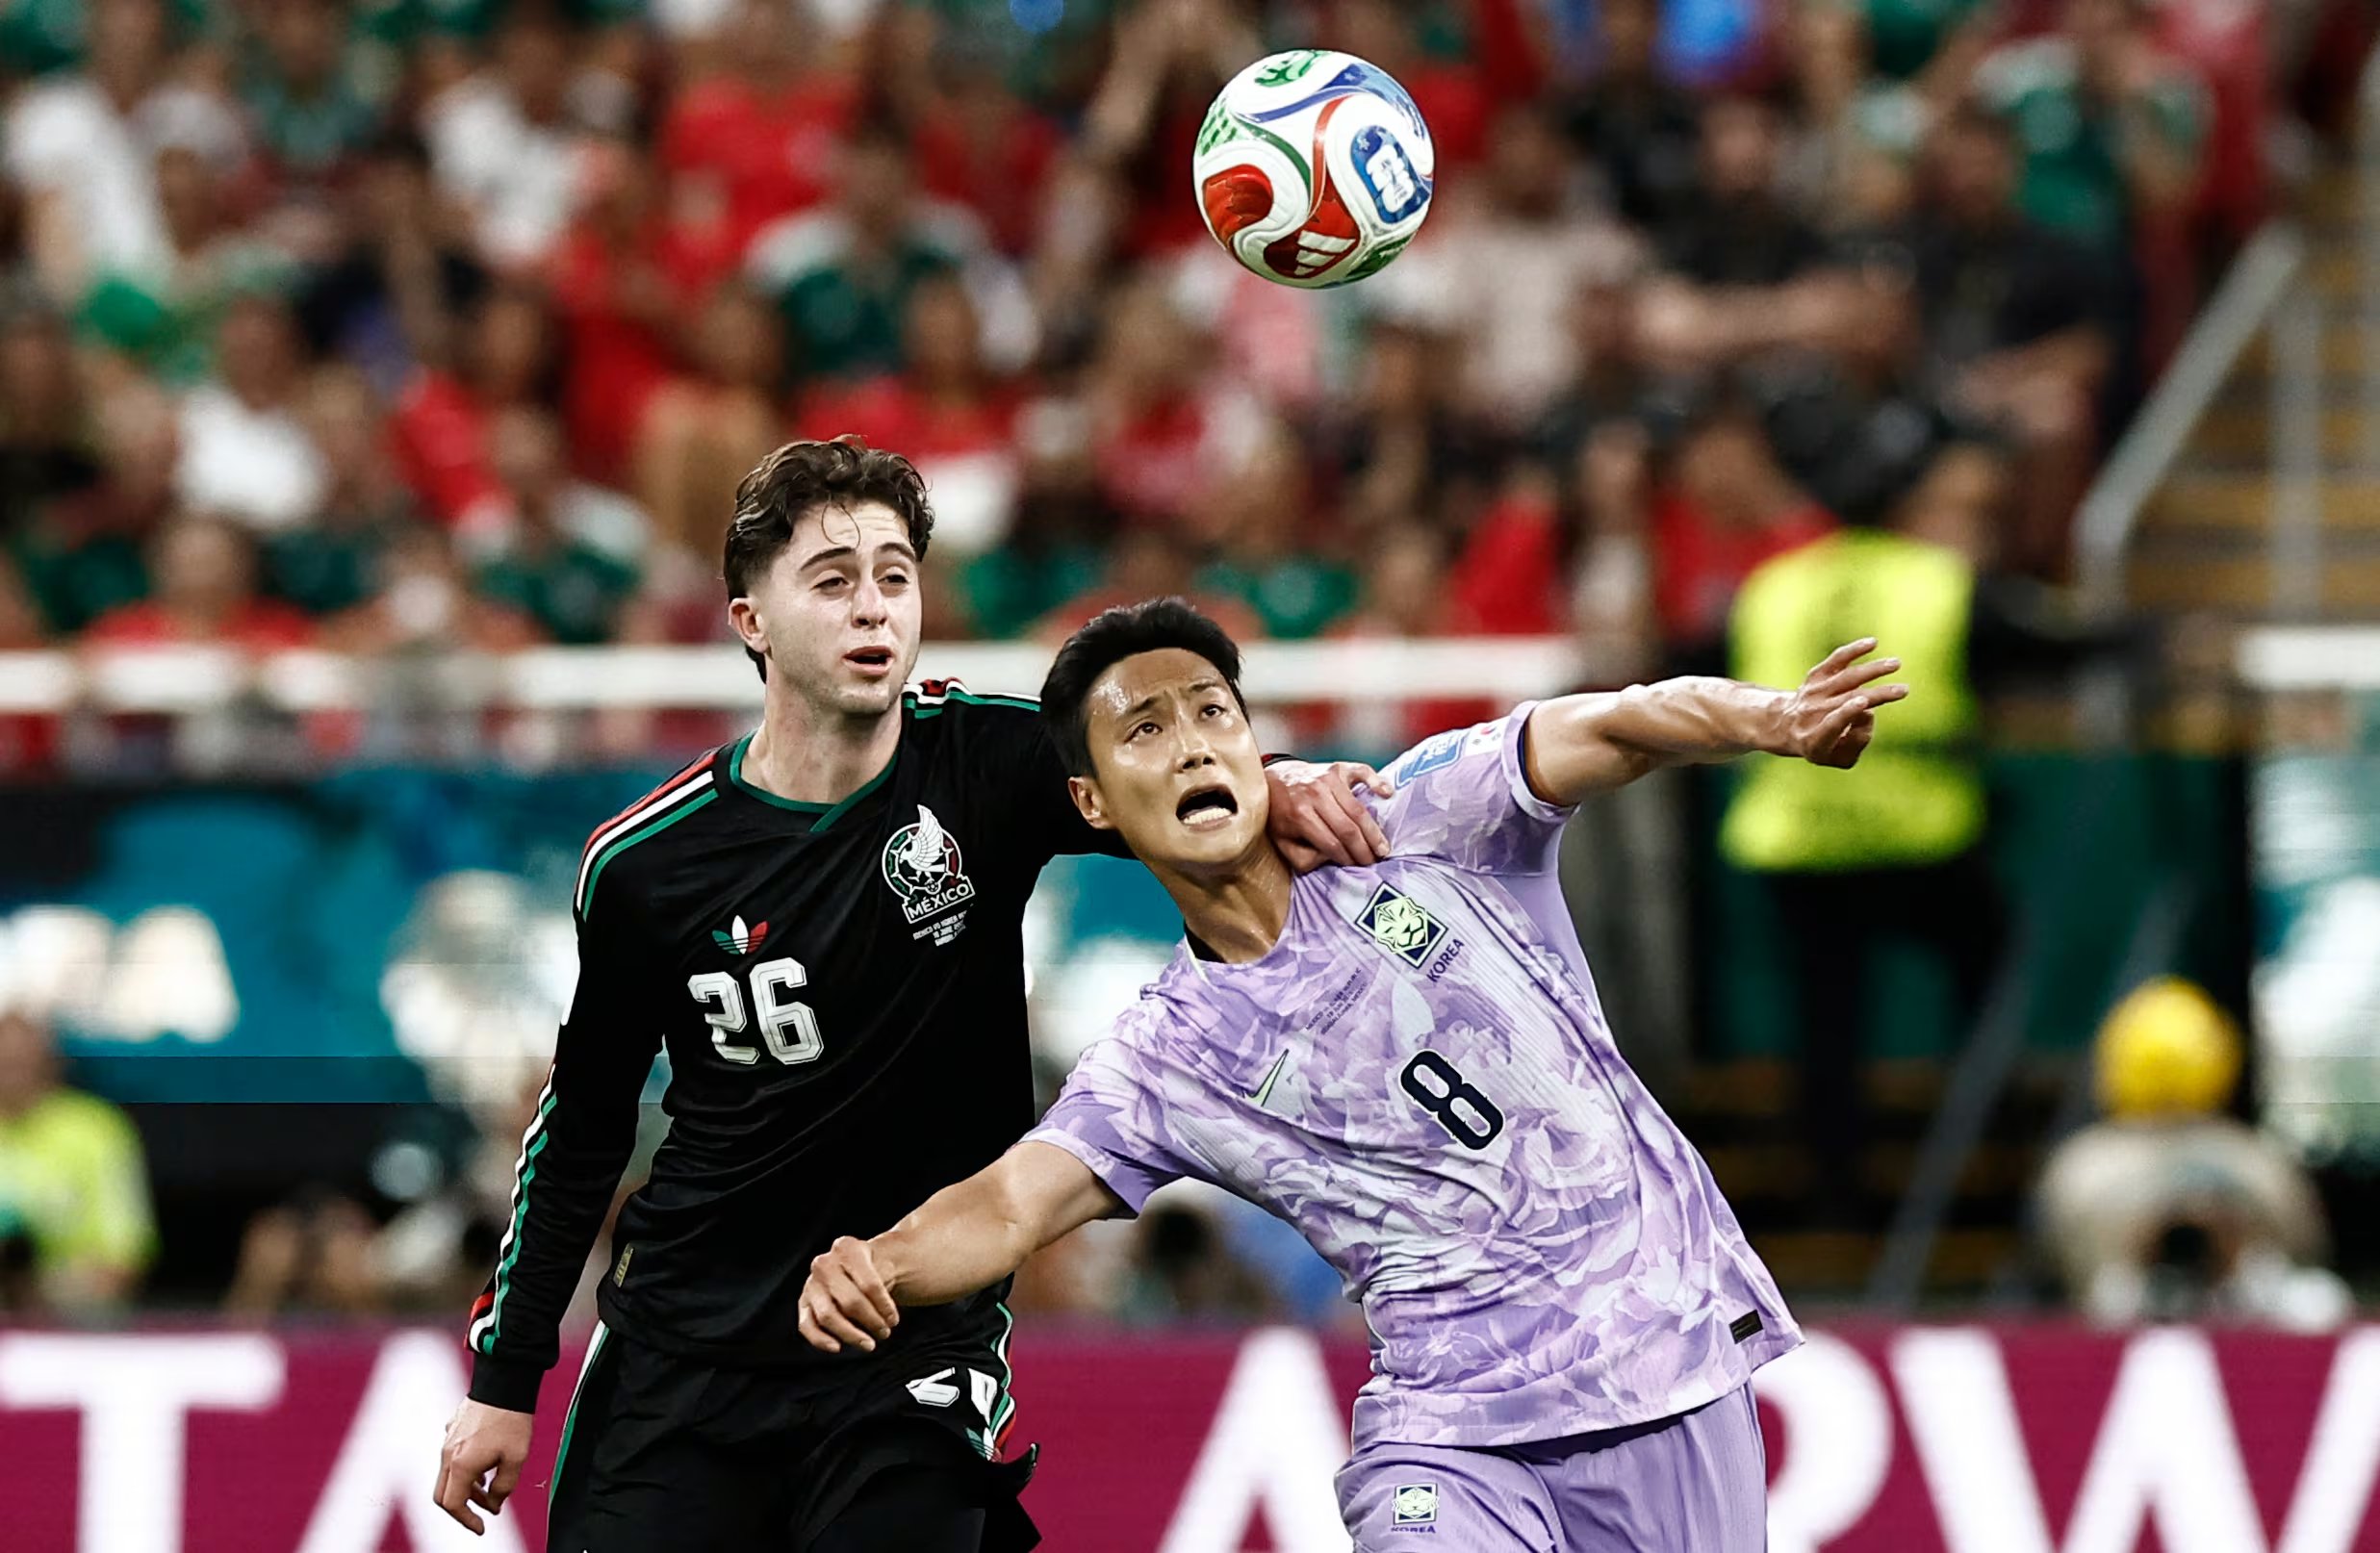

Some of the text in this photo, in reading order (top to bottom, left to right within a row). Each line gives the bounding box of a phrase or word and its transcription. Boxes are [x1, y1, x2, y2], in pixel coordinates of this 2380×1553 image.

[907, 883, 970, 920] MÉXICO
[1426, 938, 1465, 983] KOREA
[687, 956, 825, 1066] 26
[1399, 1049, 1504, 1151] 8
